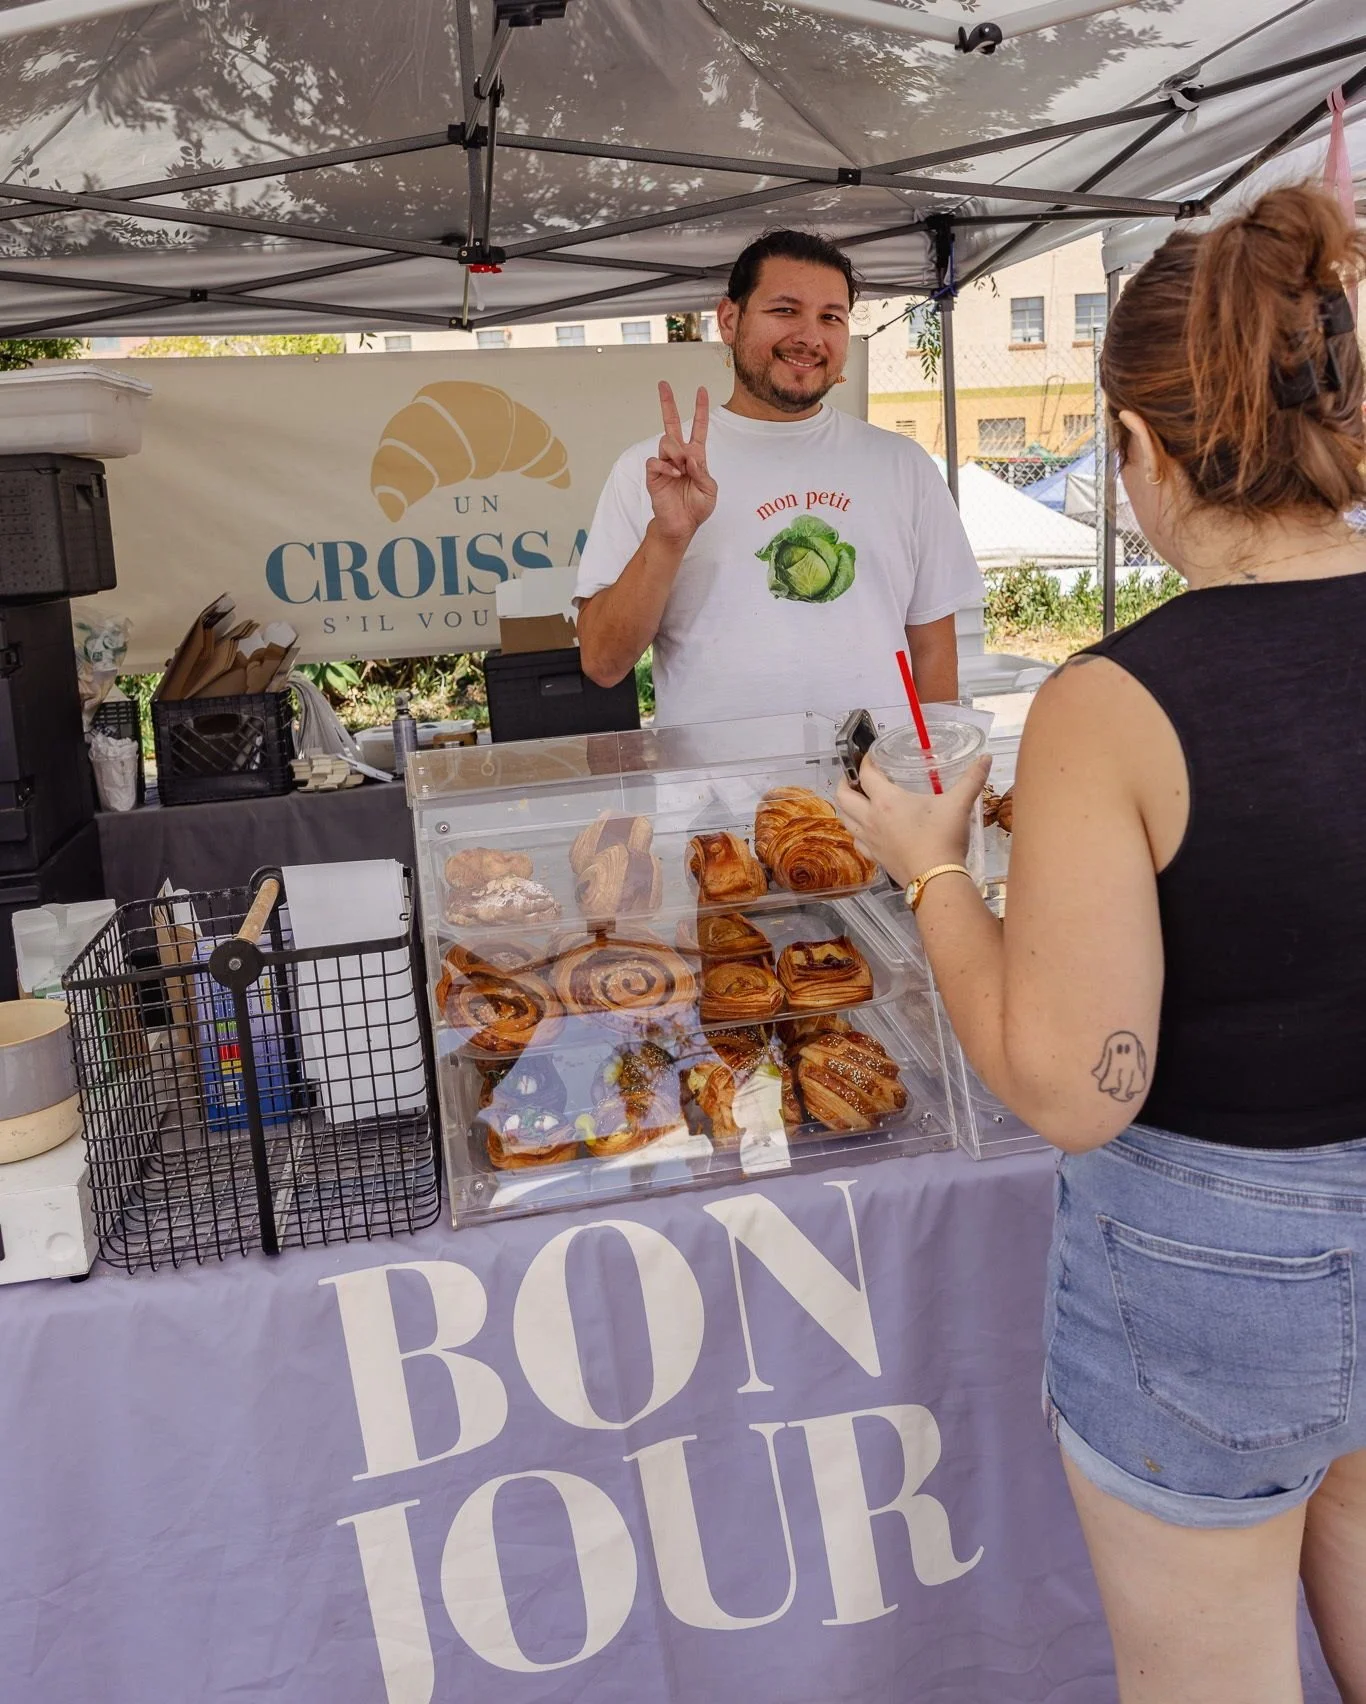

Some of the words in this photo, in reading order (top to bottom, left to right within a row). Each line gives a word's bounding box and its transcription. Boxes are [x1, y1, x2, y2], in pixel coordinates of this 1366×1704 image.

[453, 494, 499, 514] UN
[756, 493, 799, 521] mon
[805, 490, 853, 513] petit
[318, 1180, 882, 1482] BON
[337, 1403, 985, 1704] JOUR
